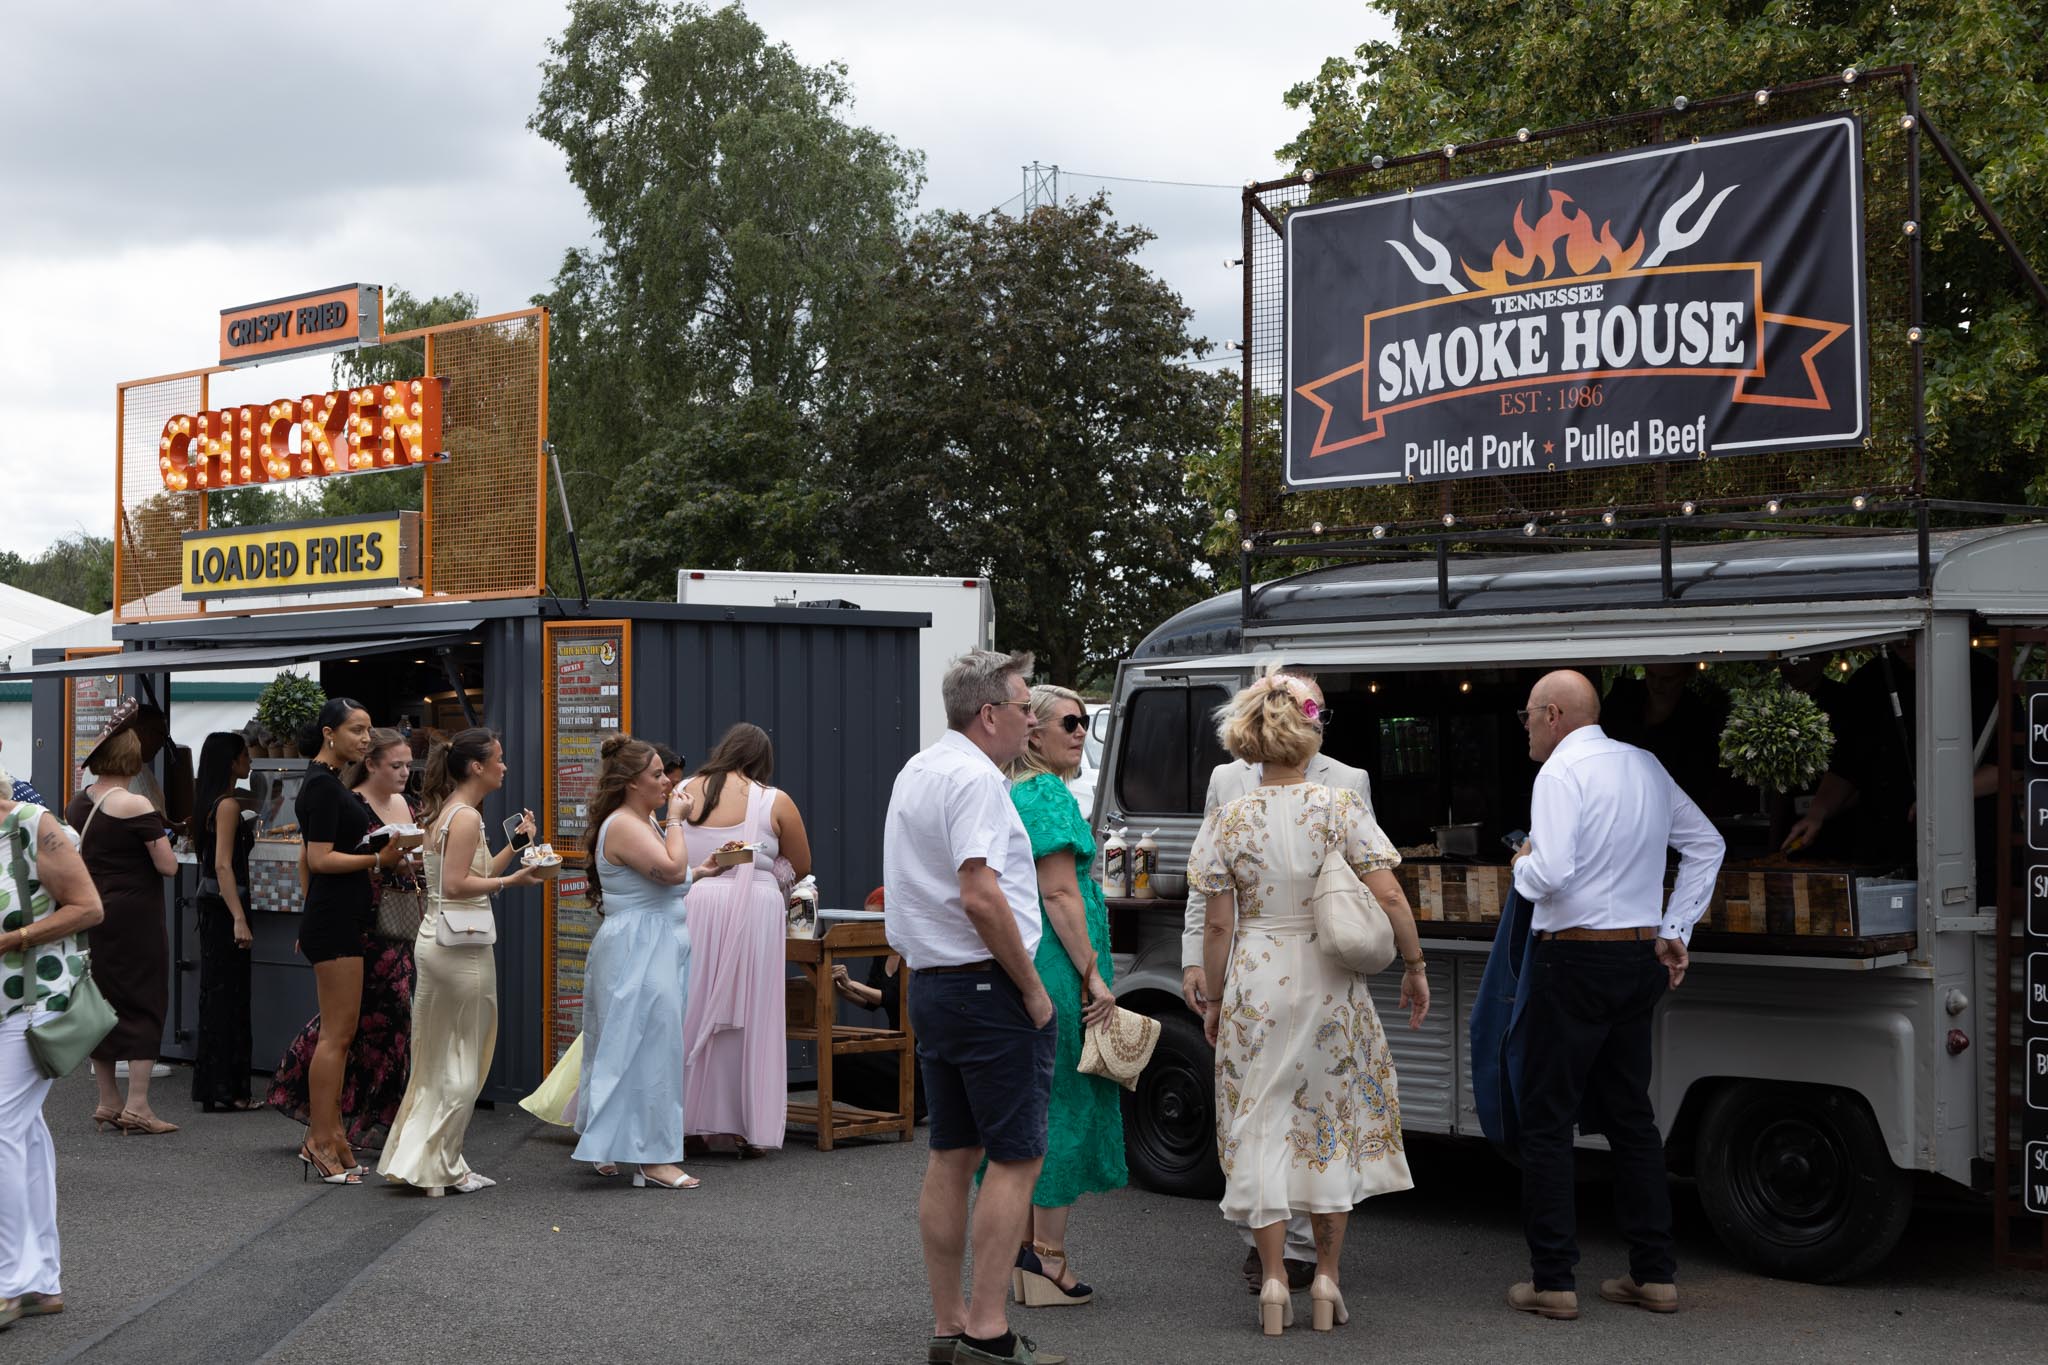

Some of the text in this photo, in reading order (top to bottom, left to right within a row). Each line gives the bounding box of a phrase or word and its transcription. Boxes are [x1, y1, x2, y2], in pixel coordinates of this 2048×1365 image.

[227, 301, 347, 346] CRISPY FRIED
[1492, 284, 1604, 315] TENNESSEE
[1378, 300, 1745, 403] SMOKE HOUSE
[1558, 384, 1603, 410] 1986
[160, 378, 442, 491] CHICKEN
[1404, 414, 1707, 479] Pulled Pork Pulled Beef
[191, 532, 383, 585] LOADED FRIES
[561, 881, 585, 892] LOADED
